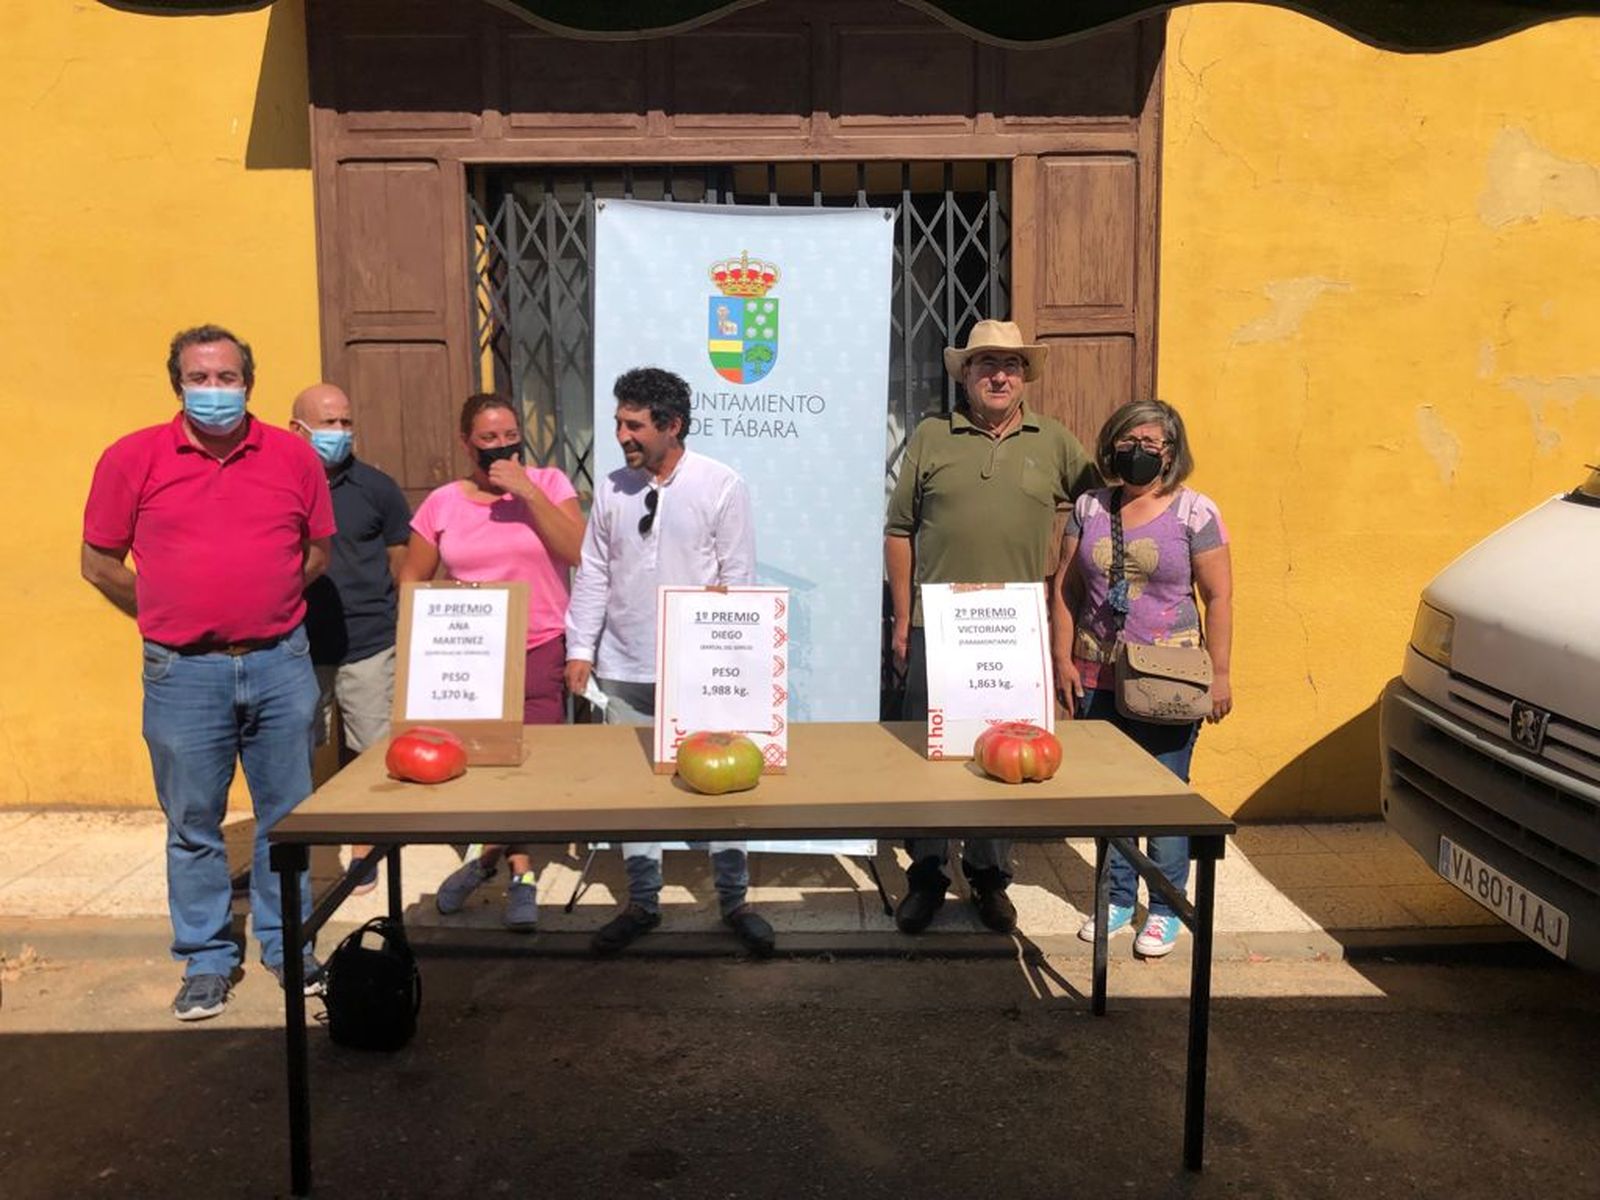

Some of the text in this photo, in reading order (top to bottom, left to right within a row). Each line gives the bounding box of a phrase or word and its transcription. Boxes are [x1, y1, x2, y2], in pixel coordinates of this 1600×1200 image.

[690, 392, 826, 415] UNTAMIENTO
[721, 414, 799, 438] TÁBARA
[427, 603, 493, 615] 3º PREMIO
[955, 607, 1017, 618] 2º PREMIO
[695, 611, 761, 623] 1º PREMIO
[448, 621, 470, 631] ANA
[957, 624, 1016, 634] VICTORIANO
[432, 636, 484, 645] MARTINEZ
[711, 630, 743, 640] DIEGO
[711, 667, 740, 677] PESO
[976, 662, 1004, 671] PESO
[441, 672, 471, 682] PESO
[968, 679, 1014, 691] 1,863 kg.
[431, 689, 478, 702] 1,370 kg.
[701, 685, 750, 698] 1,988 kg.
[927, 708, 943, 738] ho!
